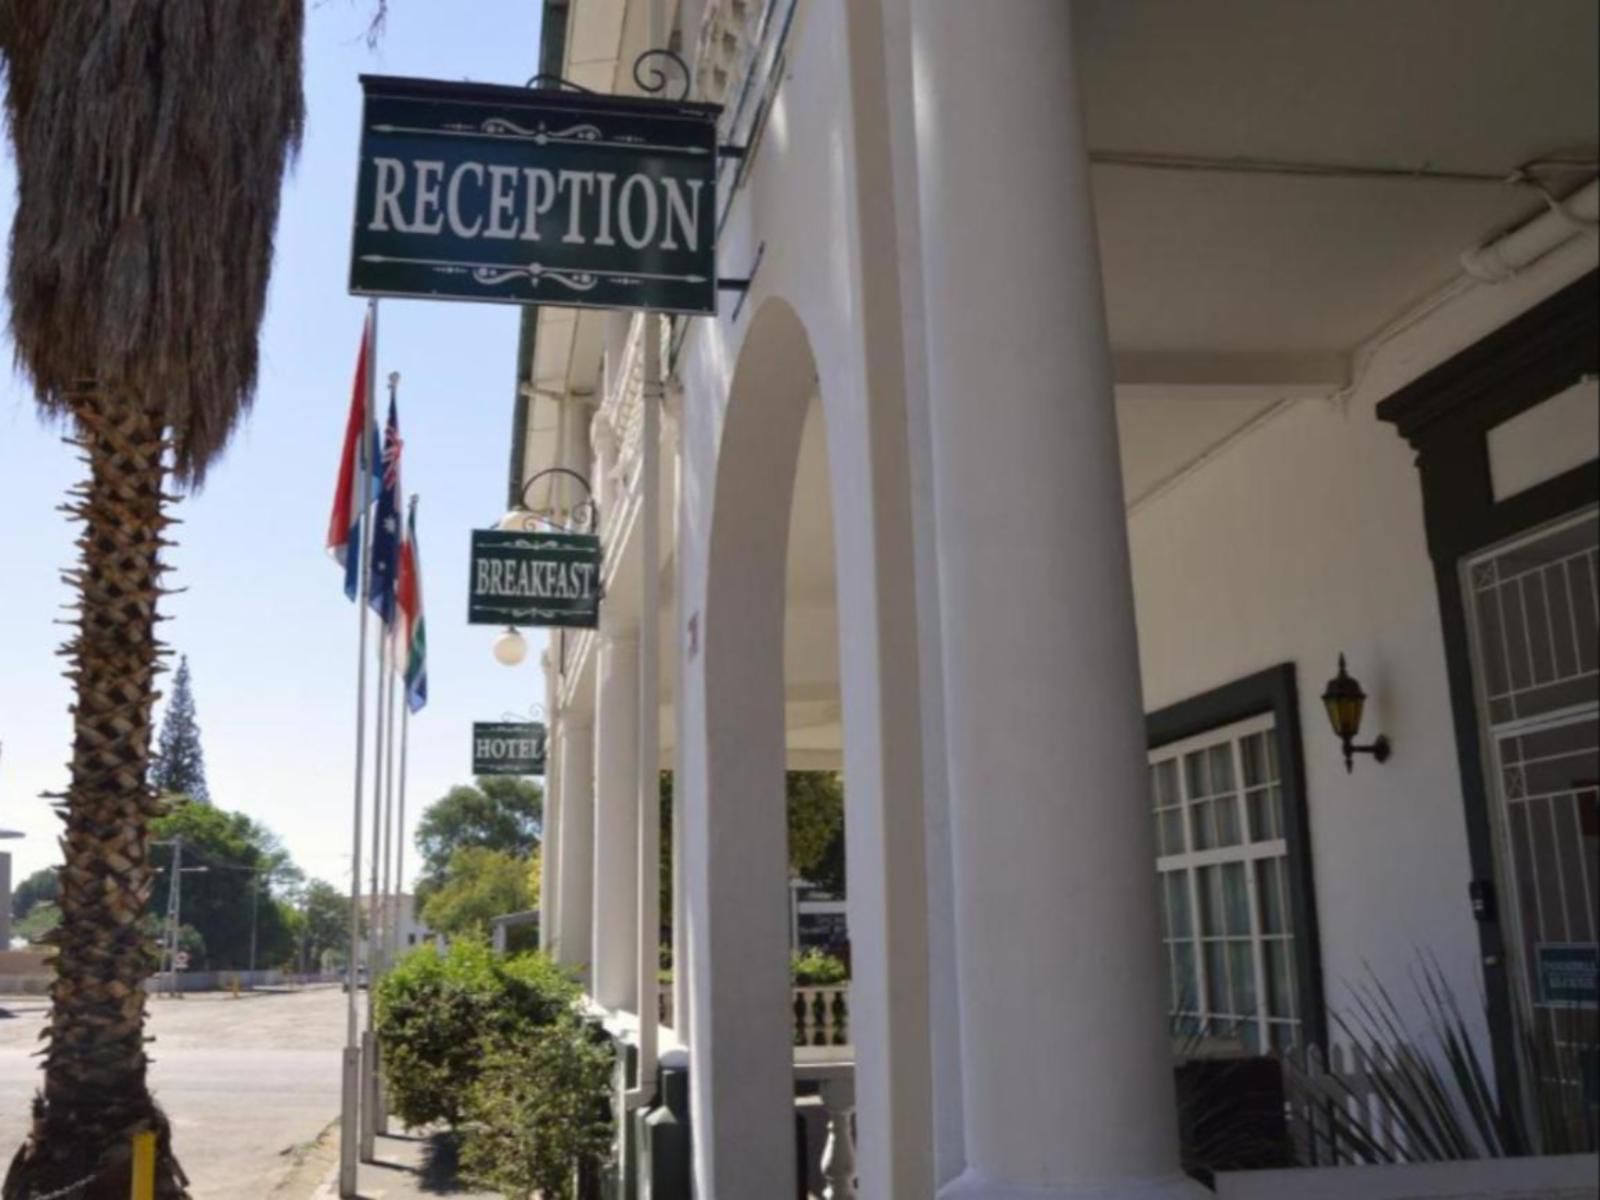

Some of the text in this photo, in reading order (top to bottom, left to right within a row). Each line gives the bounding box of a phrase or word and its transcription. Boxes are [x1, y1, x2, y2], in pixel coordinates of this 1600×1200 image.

[368, 157, 704, 251] RECEPTION
[475, 558, 594, 599] BREAKFAST
[476, 738, 541, 759] HOTEL
